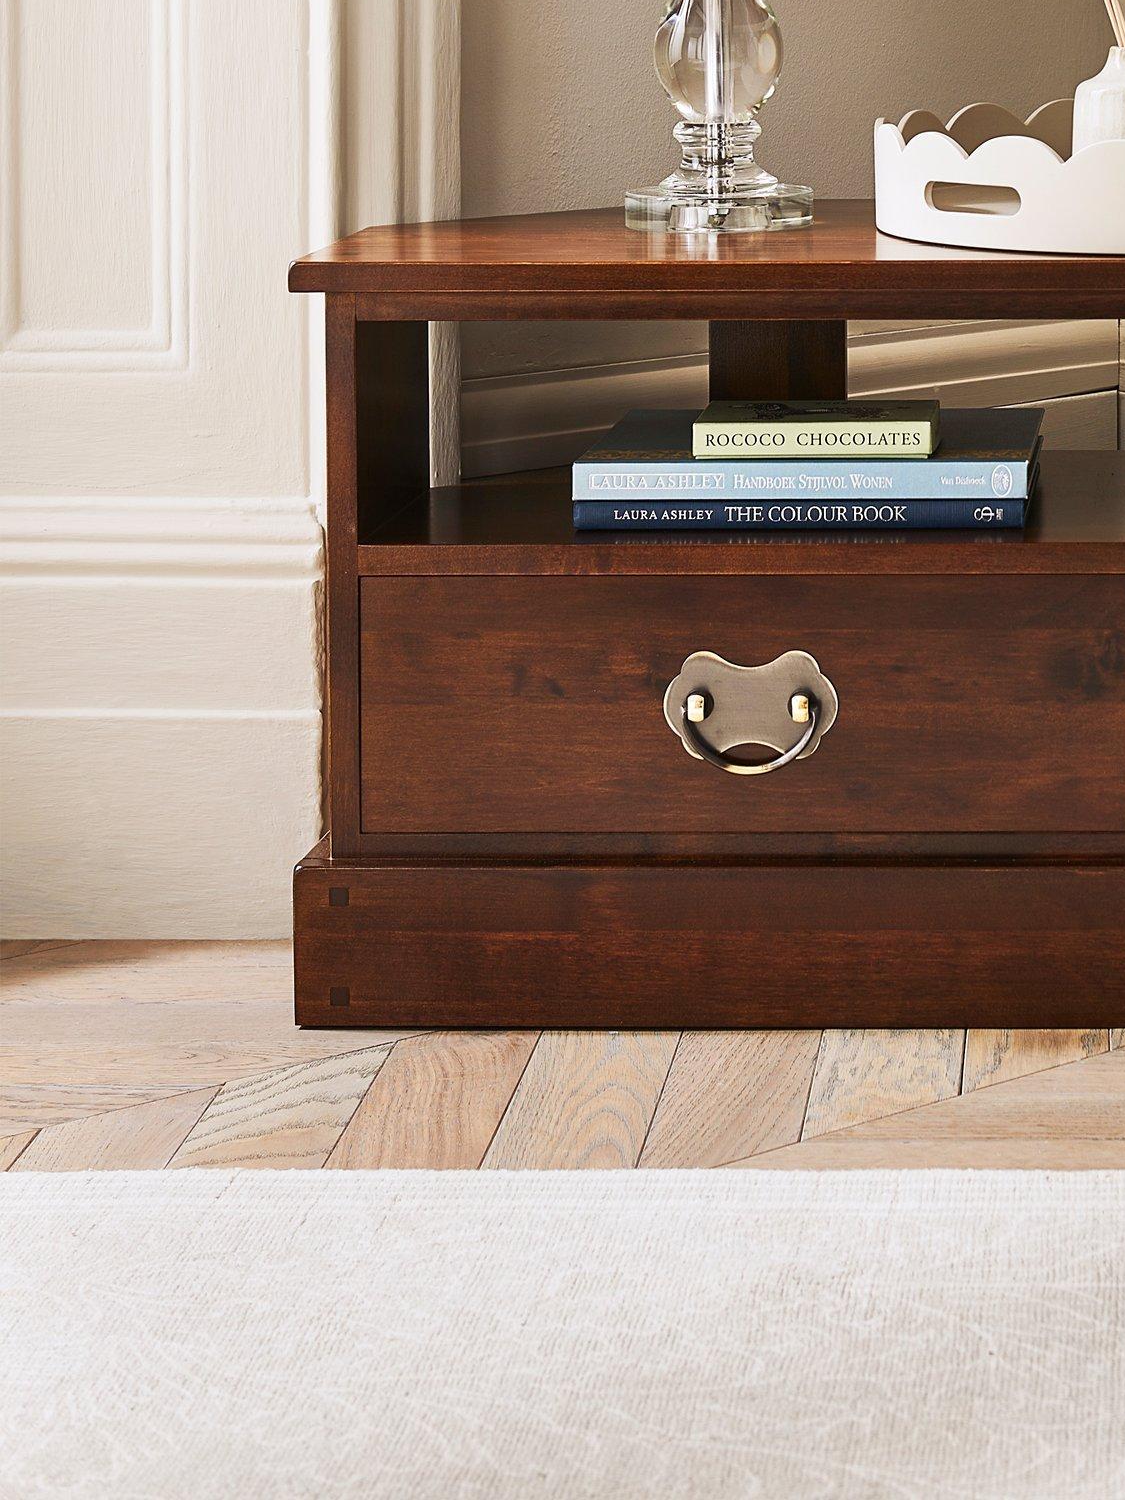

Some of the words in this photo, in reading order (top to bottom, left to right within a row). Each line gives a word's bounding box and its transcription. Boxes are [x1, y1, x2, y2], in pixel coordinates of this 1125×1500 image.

[705, 432, 786, 447] ROCOCO
[796, 432, 921, 446] CHOCOLATES
[590, 474, 648, 489] LAURA
[655, 474, 724, 488] ASHLEY
[613, 509, 658, 521] LAURA
[661, 509, 714, 521] ASHLEY
[723, 506, 765, 522] THE
[767, 505, 848, 522] COLOUR
[851, 505, 908, 522] BOOK
